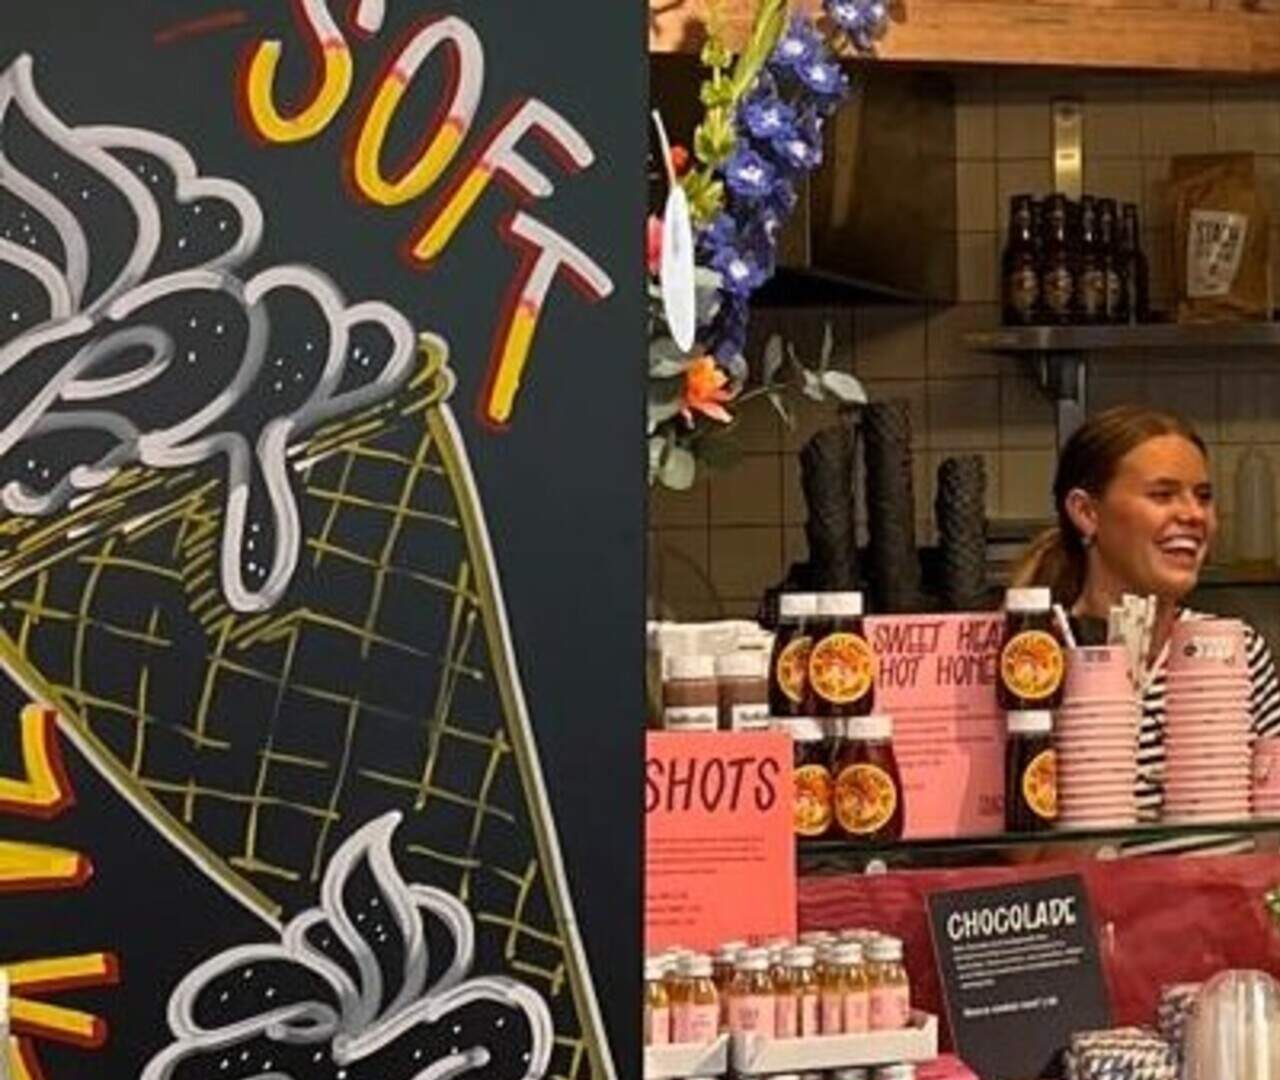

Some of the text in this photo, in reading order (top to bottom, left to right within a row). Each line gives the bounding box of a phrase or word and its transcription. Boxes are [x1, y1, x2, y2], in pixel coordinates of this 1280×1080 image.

[236, 0, 616, 431] SOFT
[873, 619, 1001, 654] SWEET HEA
[879, 653, 998, 689] HOT HONE
[646, 756, 780, 814] SHOTS
[946, 895, 1077, 941] CHOCOLADE
